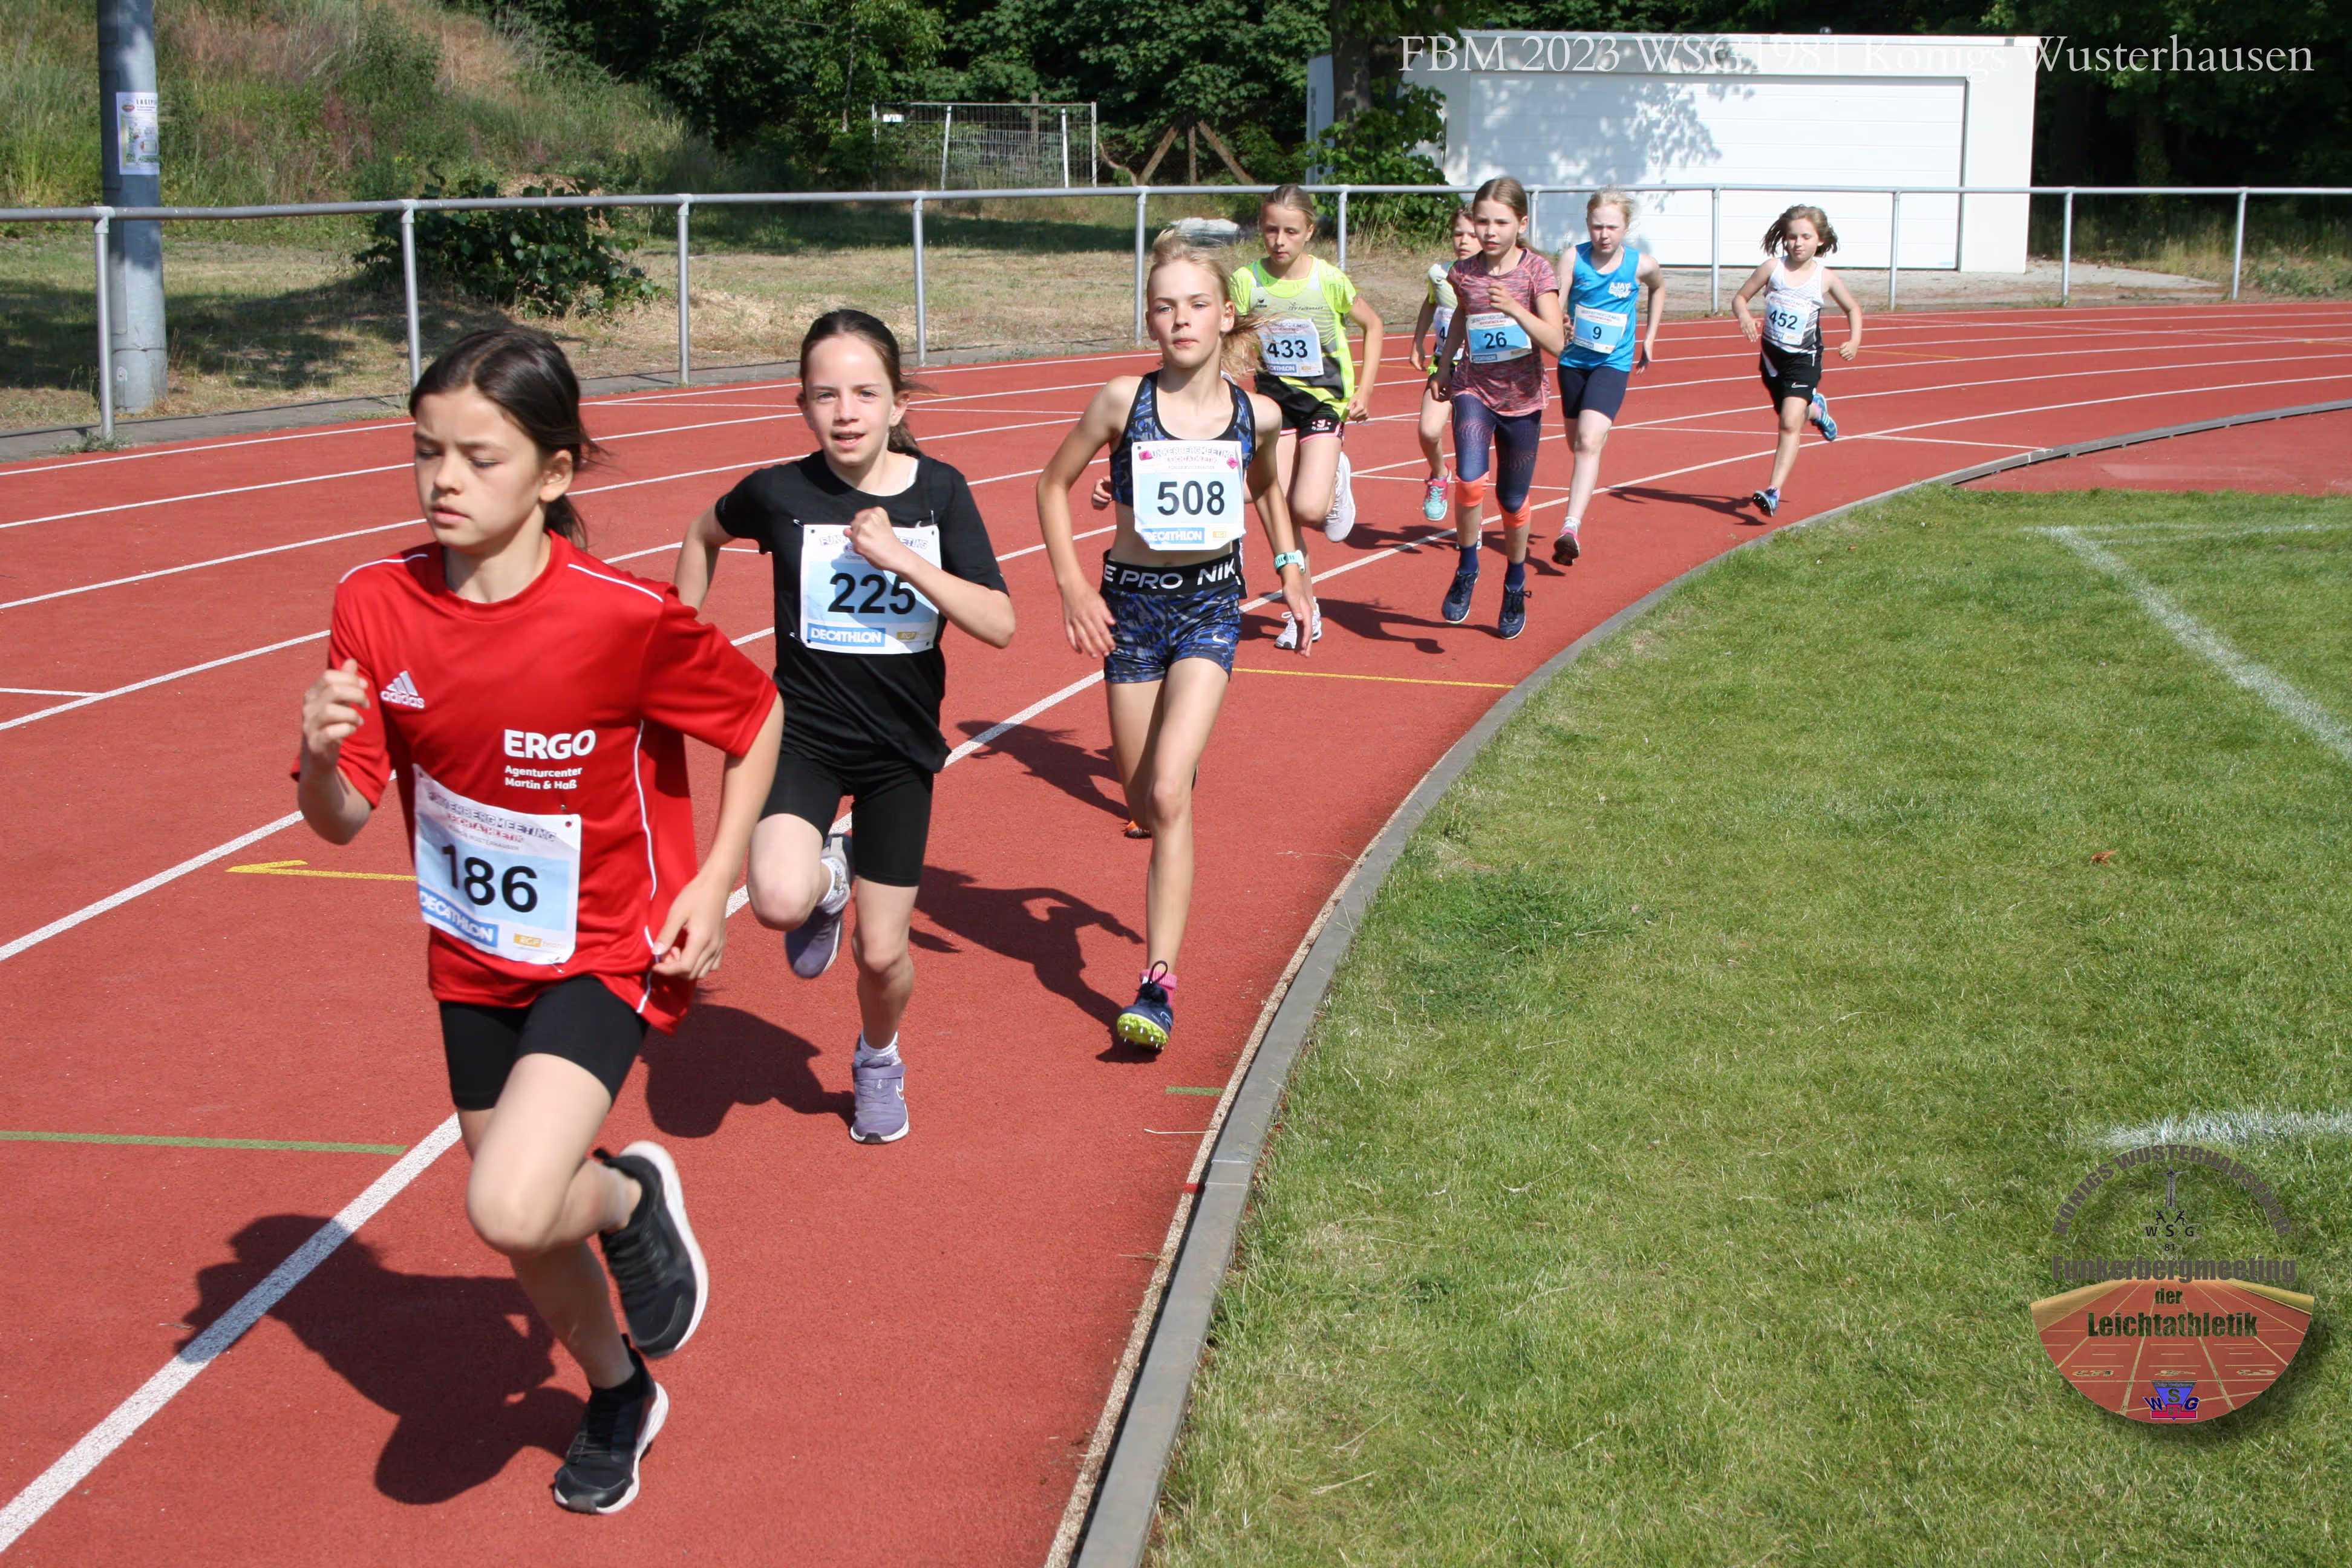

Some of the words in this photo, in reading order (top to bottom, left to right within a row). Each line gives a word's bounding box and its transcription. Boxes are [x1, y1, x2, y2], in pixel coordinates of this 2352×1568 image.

[1769, 309, 1798, 330] 452
[1484, 332, 1507, 350] 26
[1592, 326, 1602, 339] 9
[1267, 339, 1308, 358] 433
[1157, 480, 1225, 515] 508
[1119, 569, 1183, 589] PRO
[1197, 558, 1241, 586] NIK
[828, 572, 916, 615] 225
[811, 628, 882, 643] DECATHLON
[380, 690, 425, 709] adidas
[504, 728, 596, 760] ERGO
[505, 765, 583, 779] Agenturcenter
[505, 777, 541, 789] Martin
[543, 780, 552, 789] &
[554, 779, 577, 789] Haß
[442, 843, 538, 913] 186
[419, 890, 494, 942] DECATHLON
